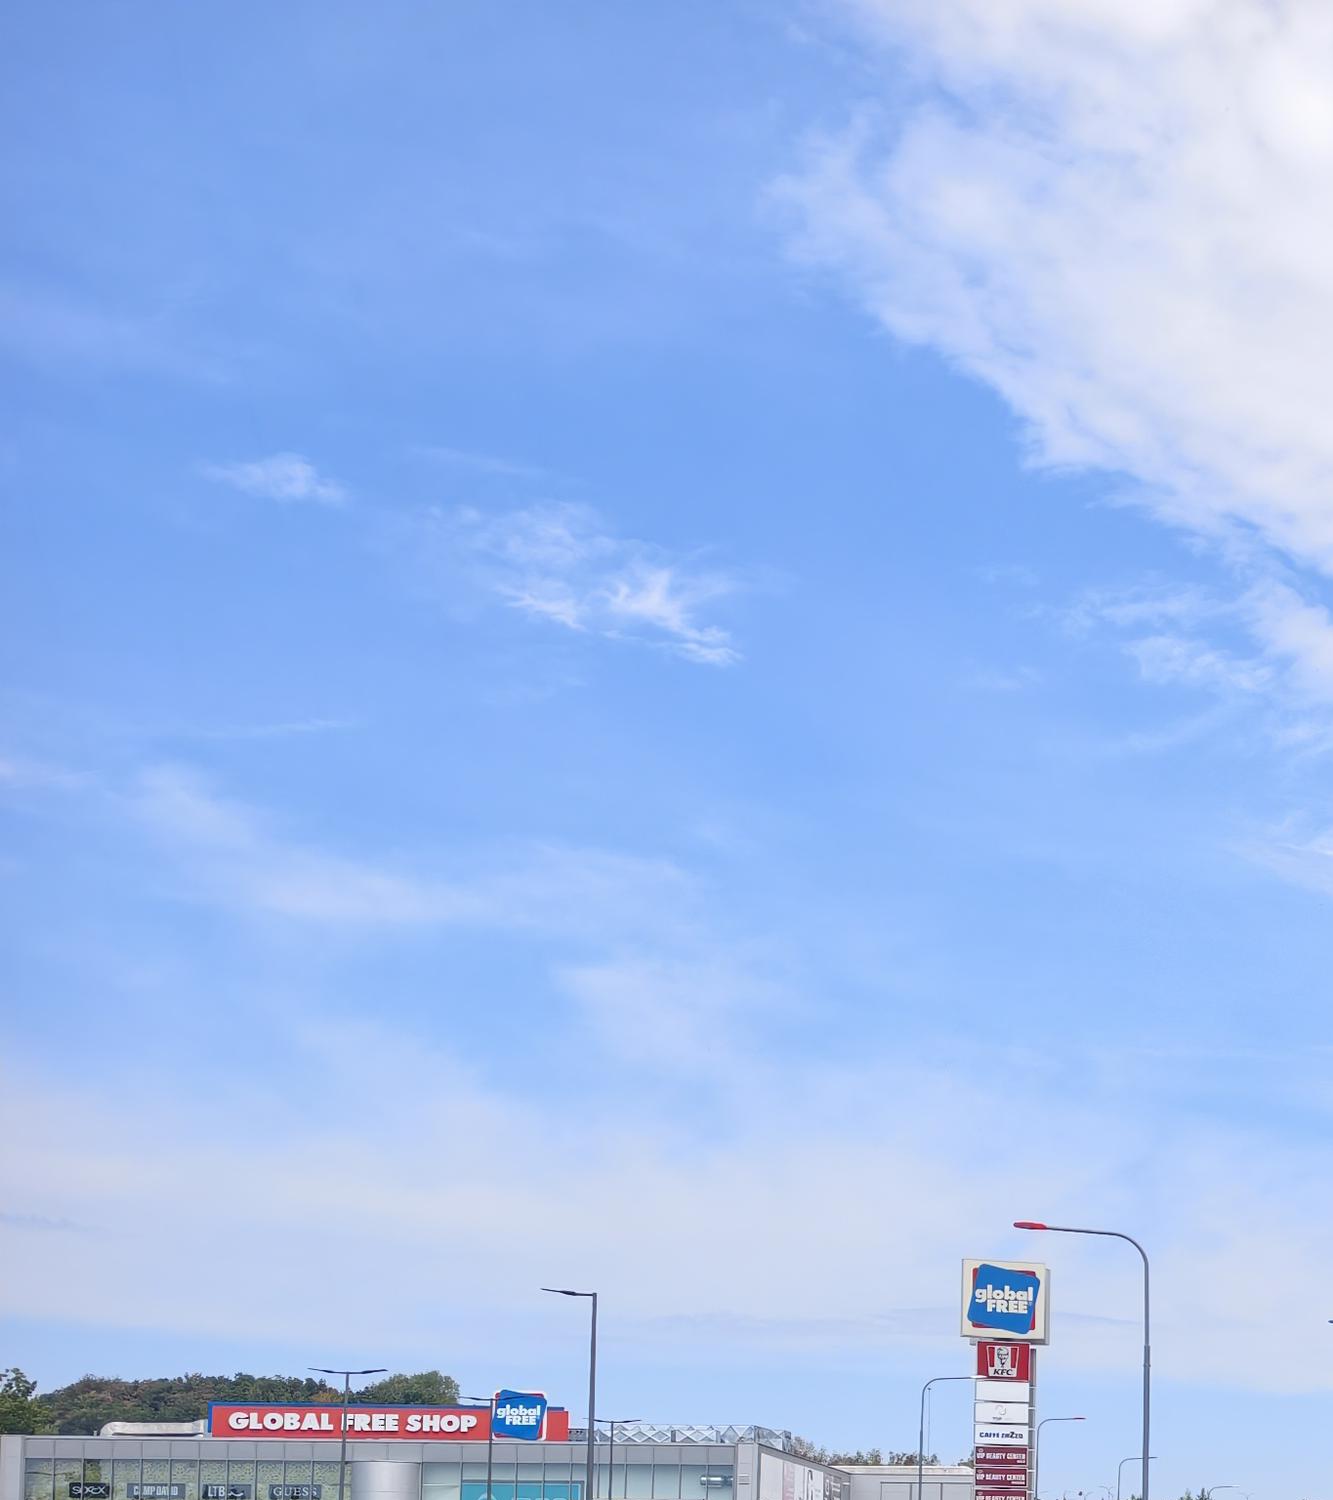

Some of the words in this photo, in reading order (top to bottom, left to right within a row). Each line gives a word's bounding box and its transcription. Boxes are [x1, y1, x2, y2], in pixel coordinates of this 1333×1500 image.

[975, 1284, 1034, 1303] global
[987, 1300, 1029, 1314] FREE
[497, 1404, 541, 1419] global
[228, 1412, 333, 1431] GLOBAL
[341, 1413, 399, 1432] FREE
[405, 1414, 478, 1433] SHOP
[505, 1415, 538, 1426] FREE
[207, 1486, 226, 1497] LTB
[272, 1486, 318, 1497] GUESS
